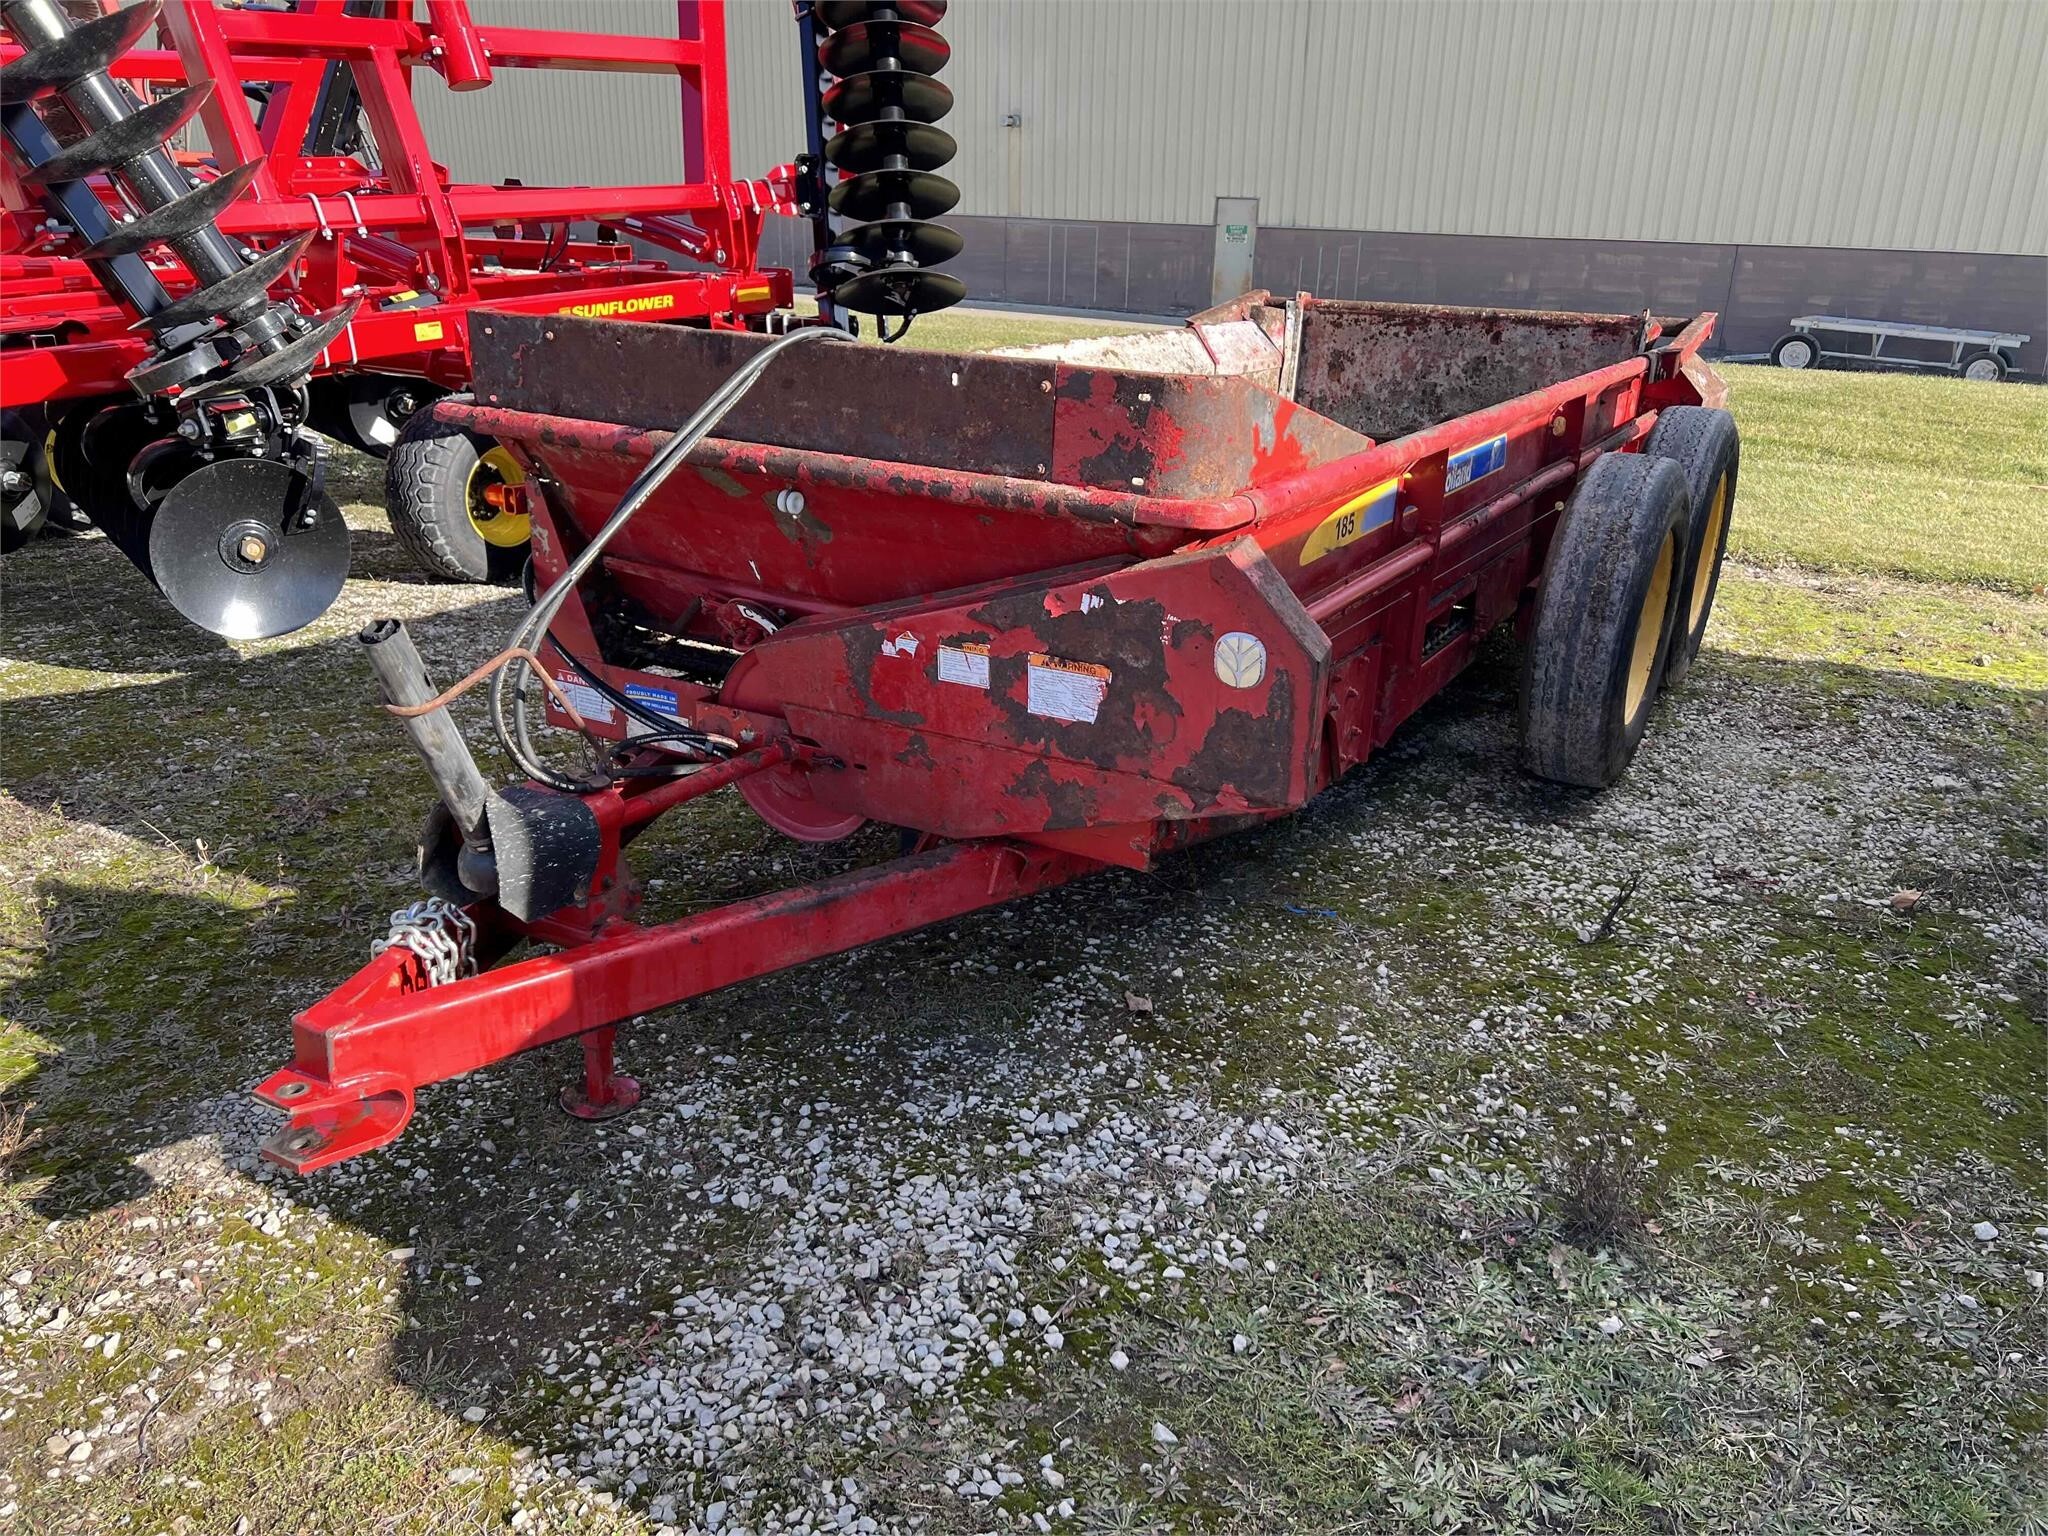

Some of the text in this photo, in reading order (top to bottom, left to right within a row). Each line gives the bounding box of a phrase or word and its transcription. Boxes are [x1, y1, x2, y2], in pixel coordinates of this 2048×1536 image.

[572, 295, 673, 317] SUNFLOWER
[1445, 457, 1472, 492] olland
[1336, 511, 1355, 540] 185
[566, 674, 589, 686] DAN
